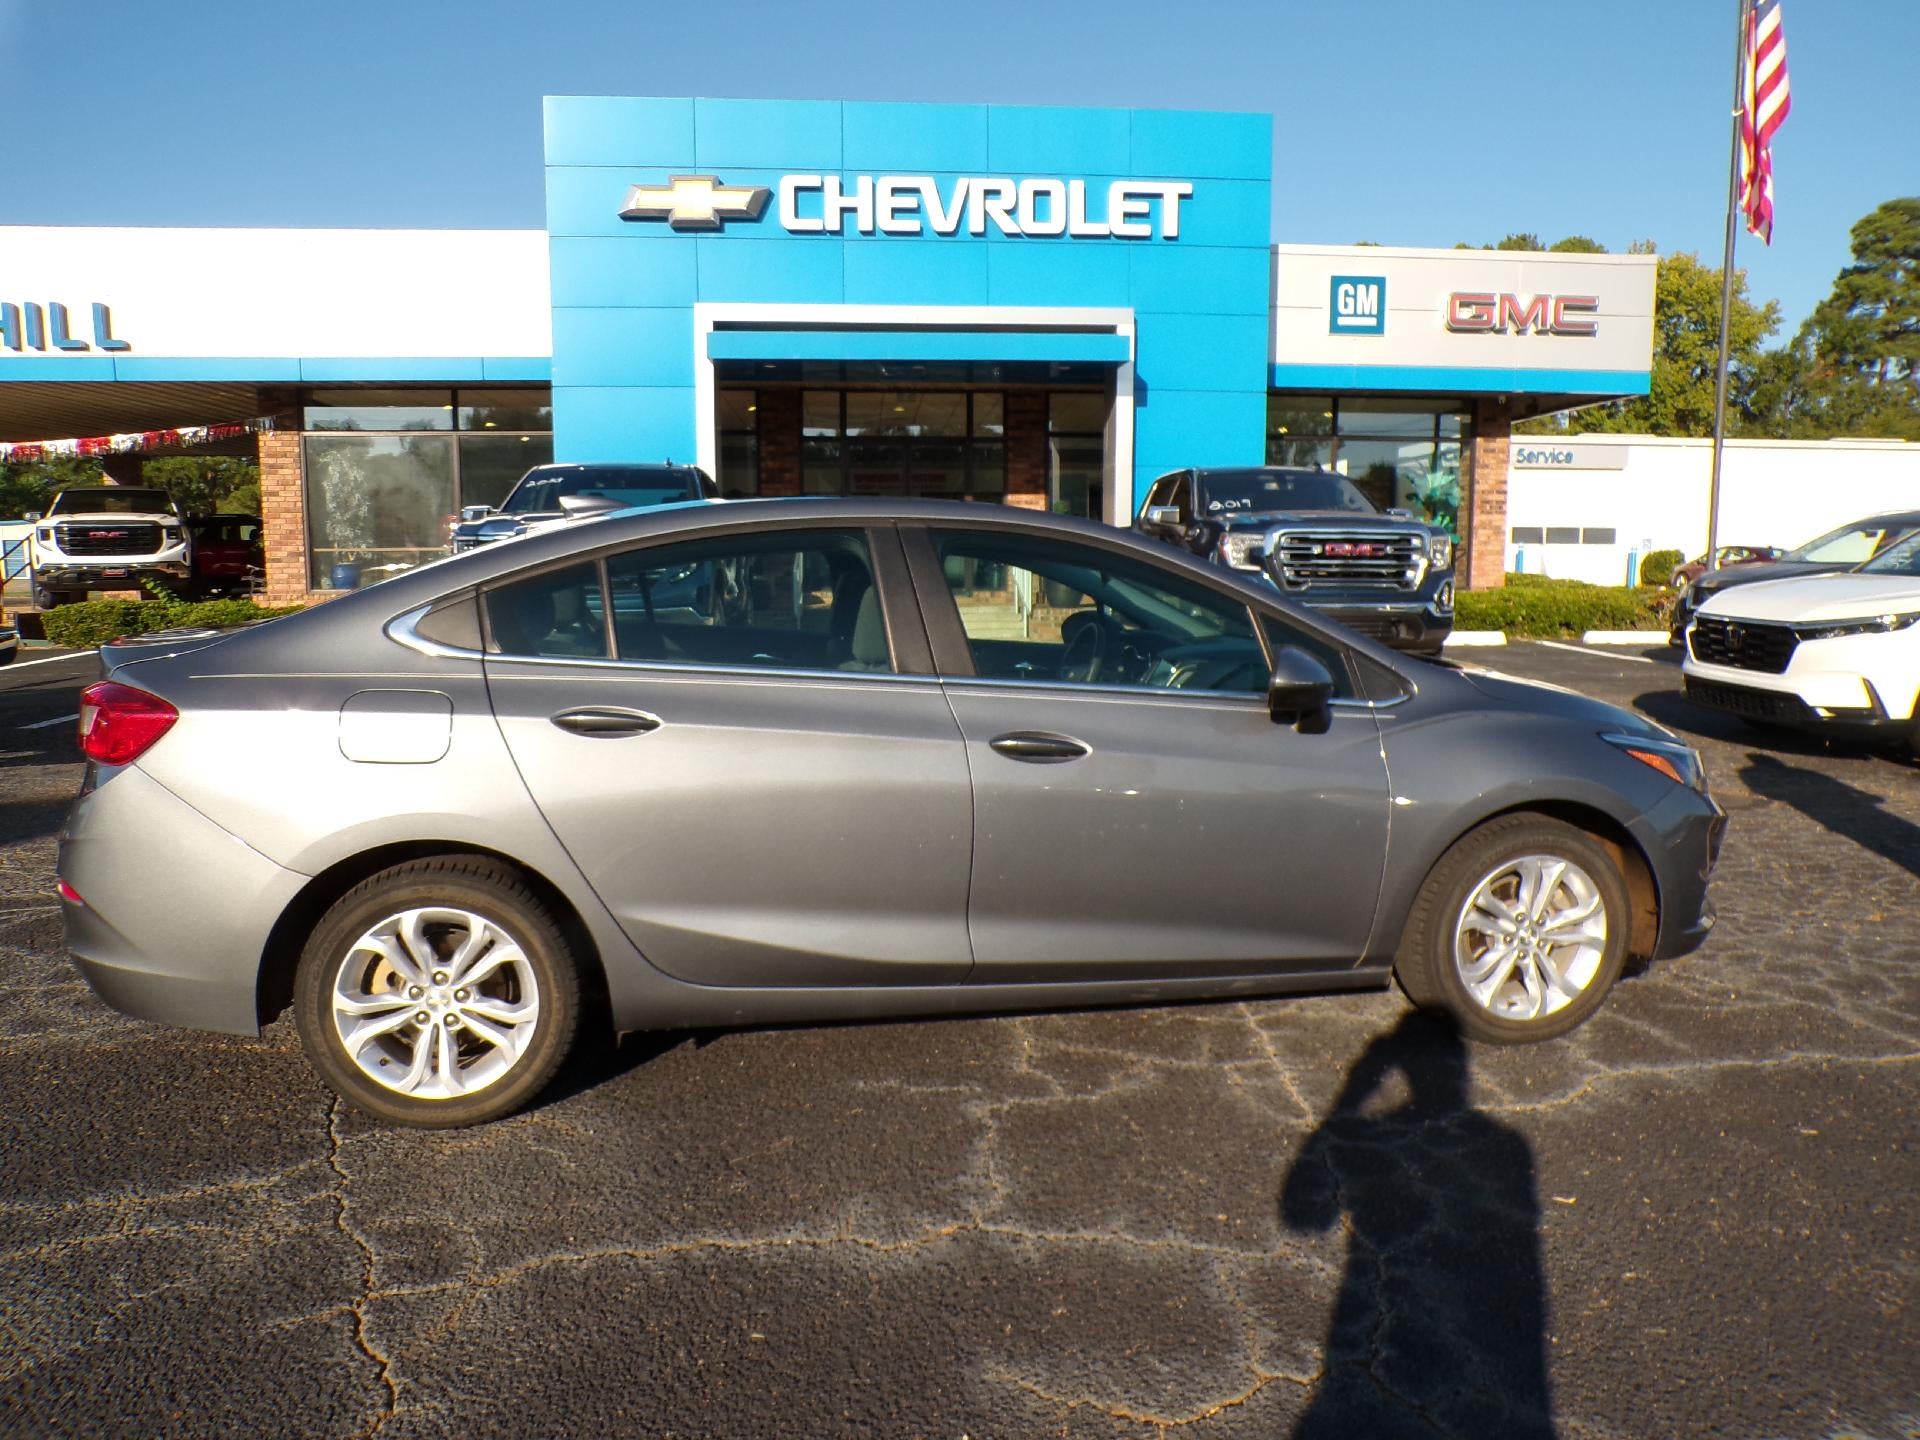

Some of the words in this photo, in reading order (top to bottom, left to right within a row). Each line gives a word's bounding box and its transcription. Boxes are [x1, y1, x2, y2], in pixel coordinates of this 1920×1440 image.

[779, 174, 1193, 240] CHEVROLET
[1337, 283, 1378, 316] GM
[1447, 291, 1599, 337] GMC
[1516, 447, 1574, 464] Service
[1324, 543, 1384, 556] GMC
